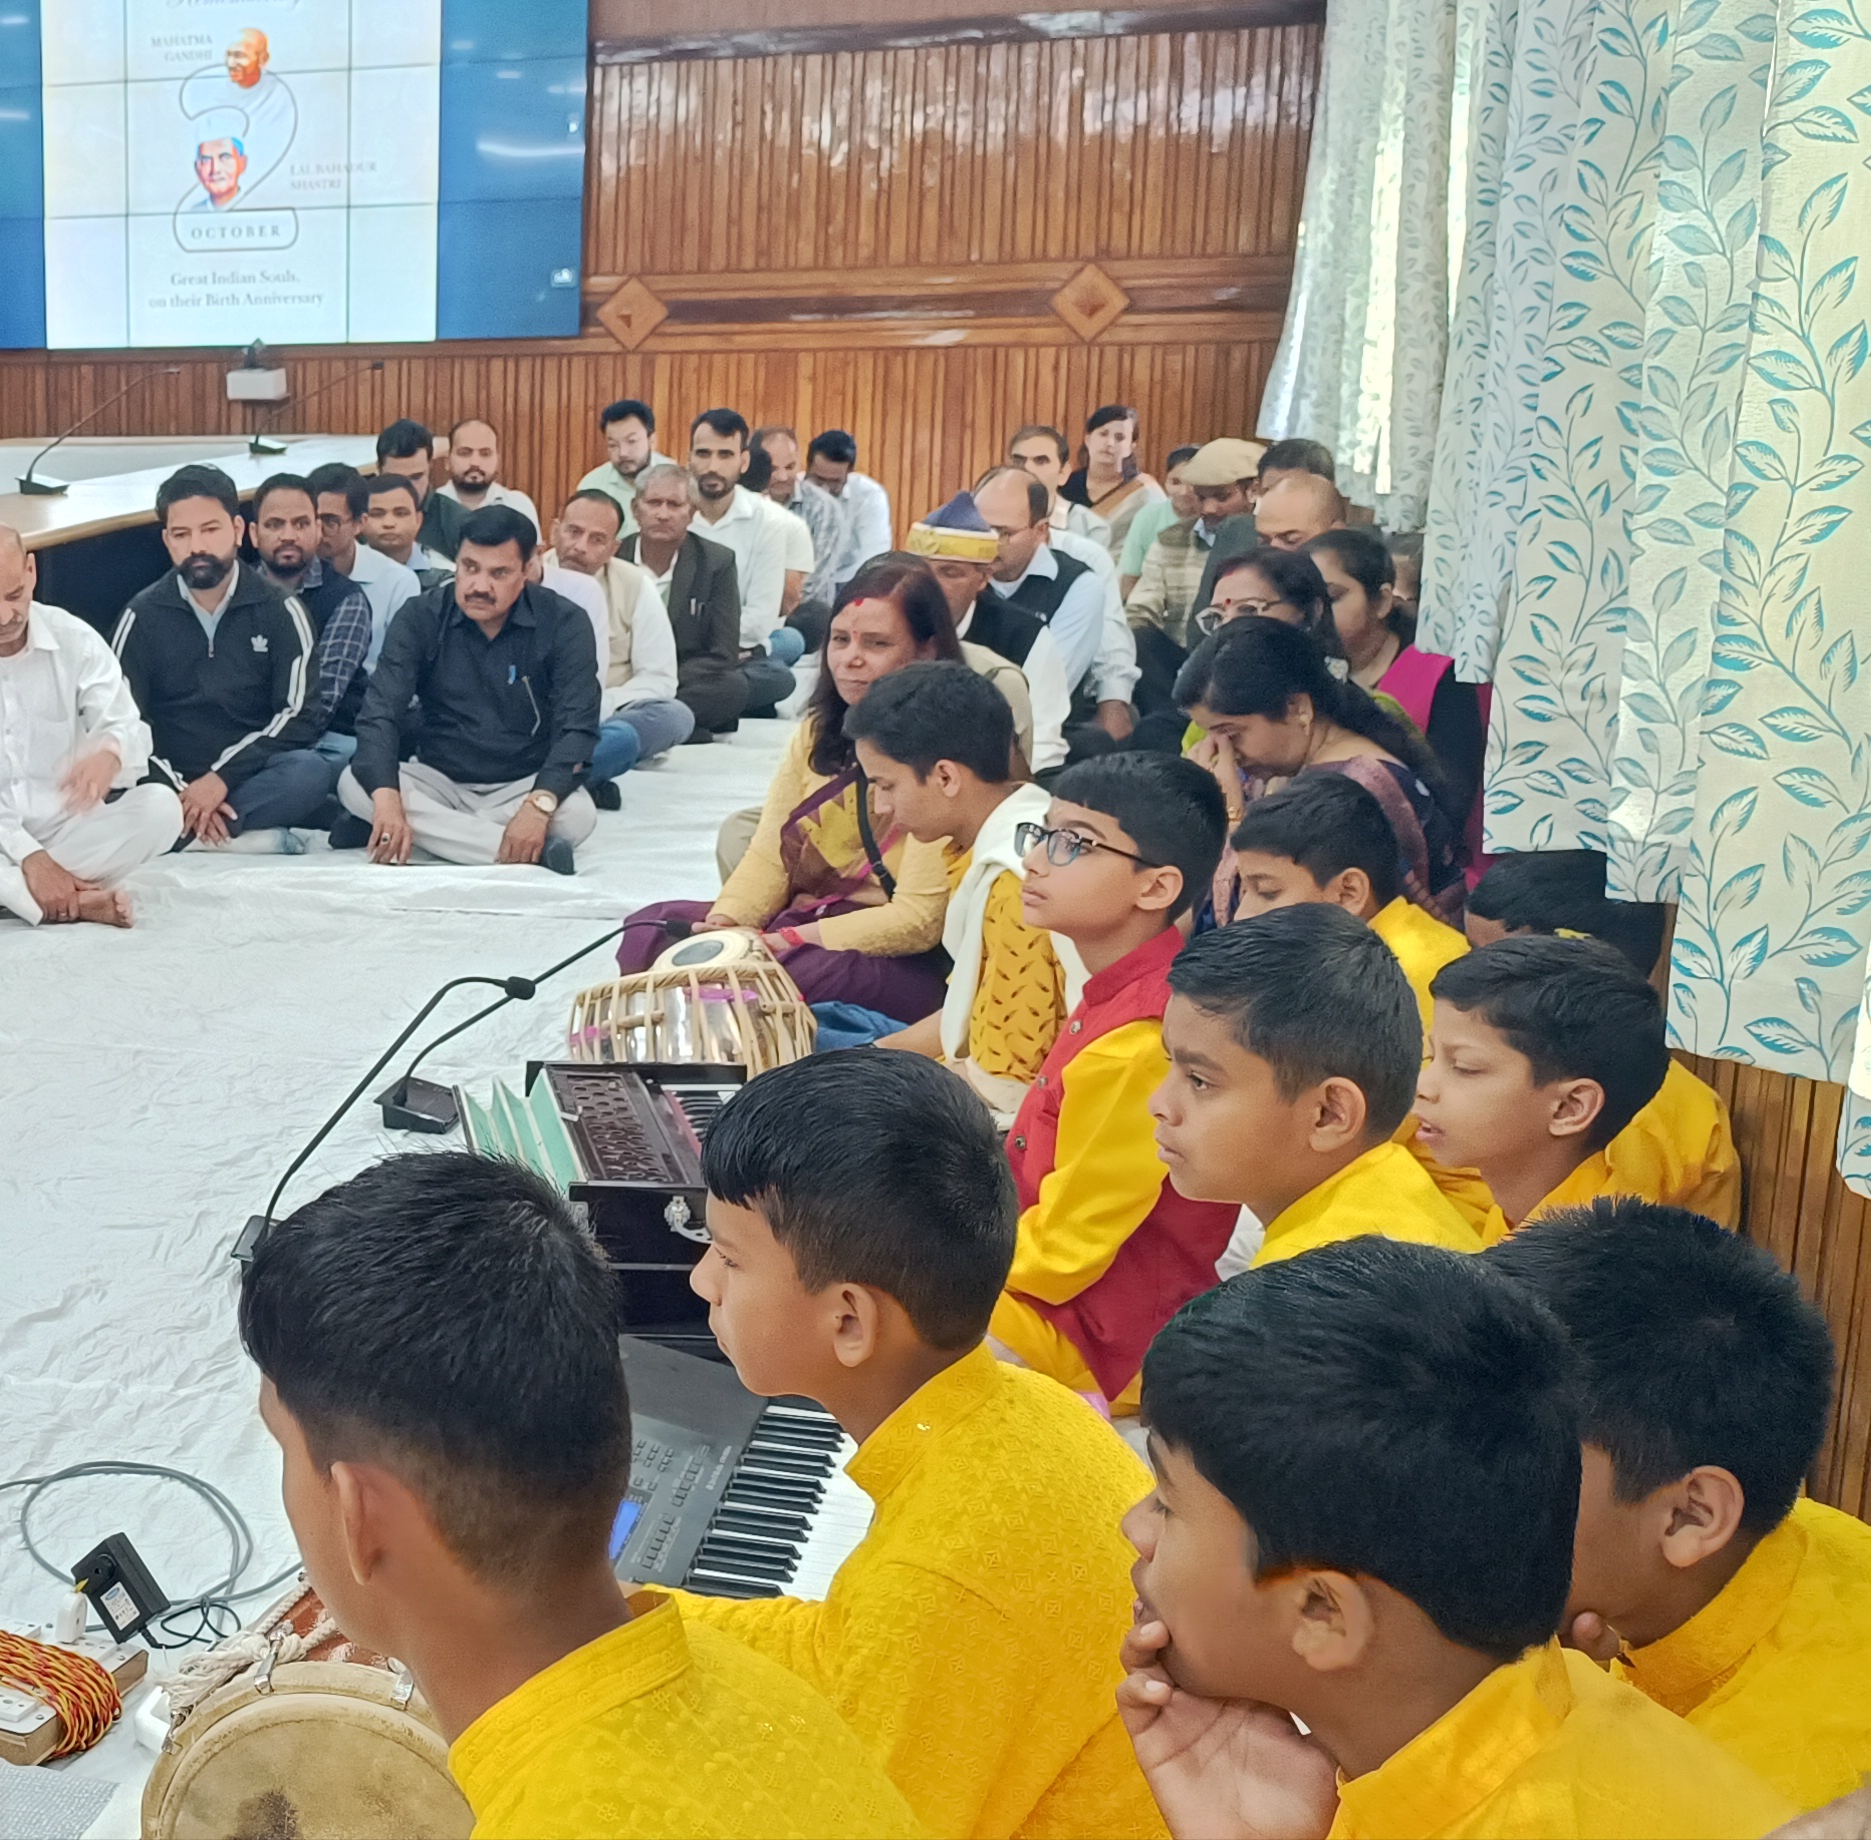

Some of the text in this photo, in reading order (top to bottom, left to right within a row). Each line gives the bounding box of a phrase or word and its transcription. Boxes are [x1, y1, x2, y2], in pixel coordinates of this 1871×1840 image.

[150, 34, 213, 48] MAHATMA
[164, 49, 213, 62] GANDHI
[289, 179, 342, 191] SHASTRI
[190, 224, 281, 240] OCTOBER
[170, 272, 208, 286] Great
[211, 271, 257, 285] Indian
[149, 290, 324, 308] on their Birth Anniversary
